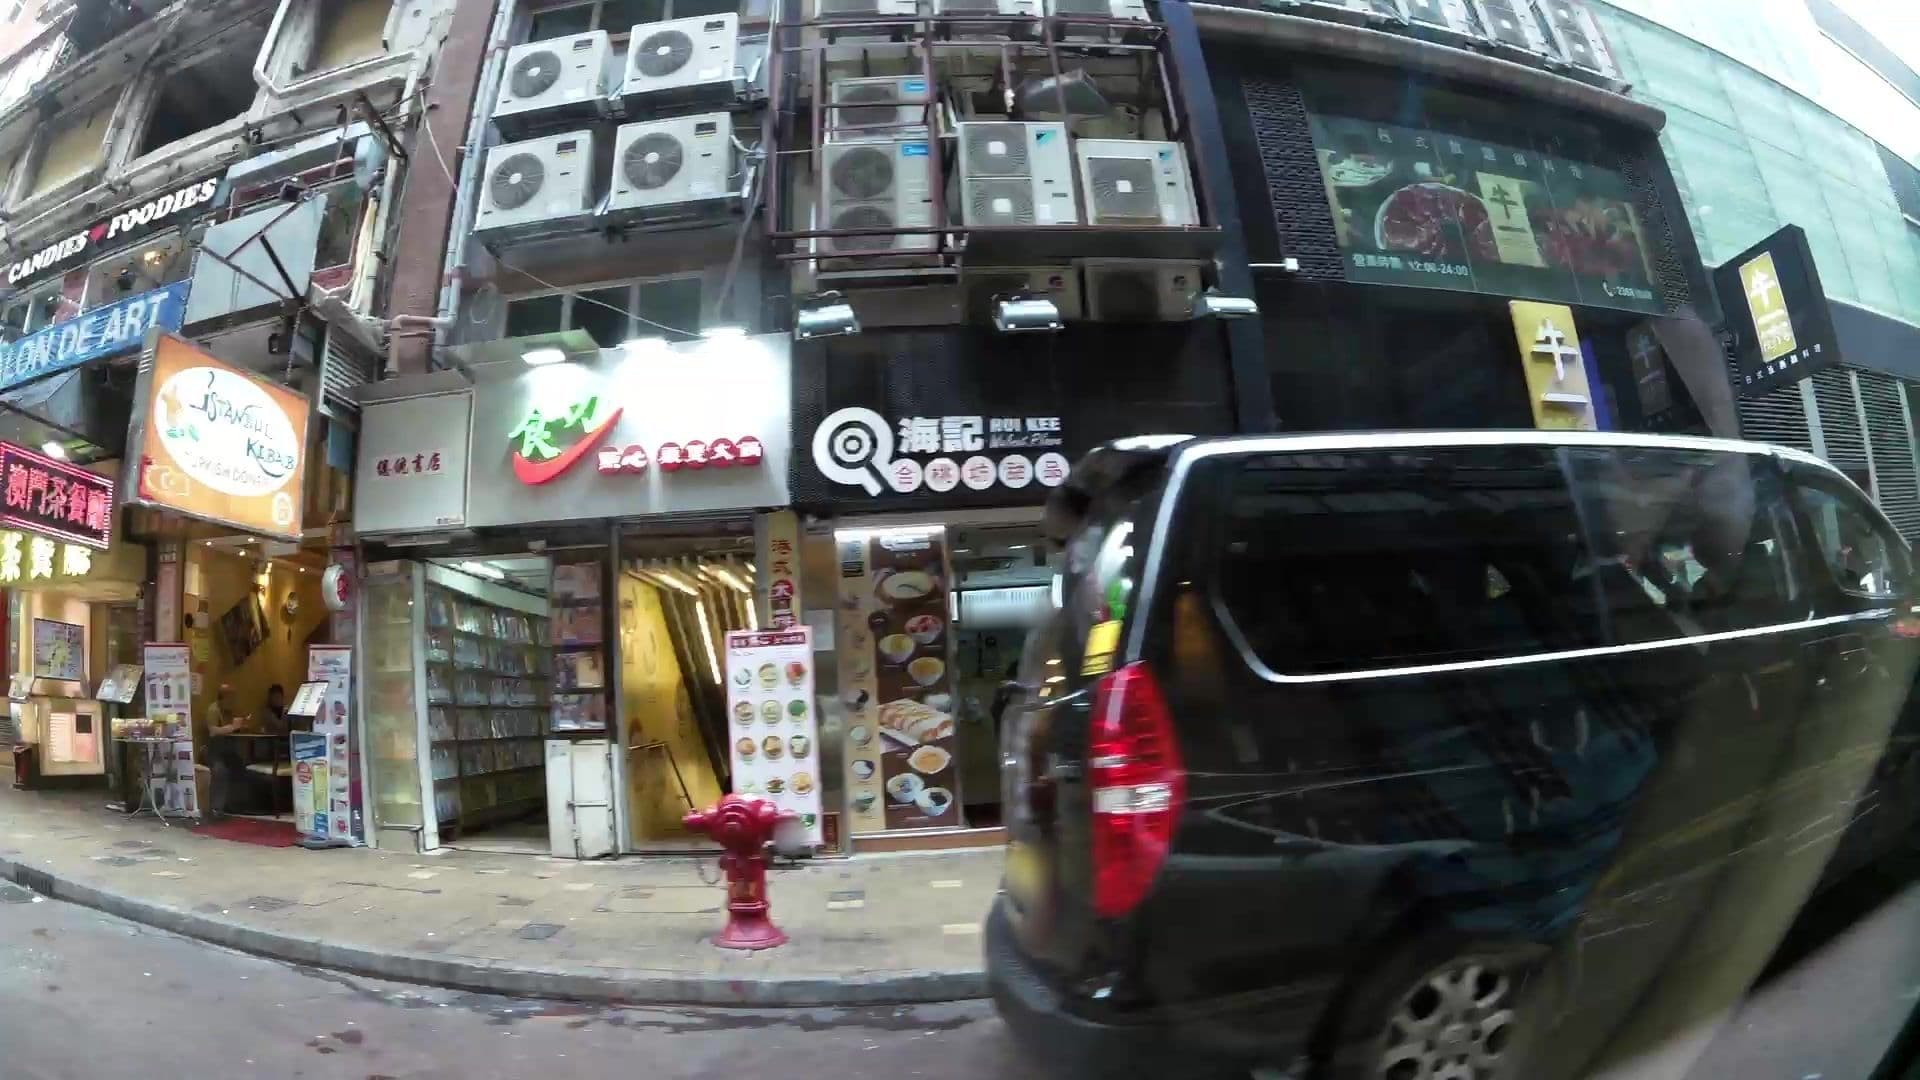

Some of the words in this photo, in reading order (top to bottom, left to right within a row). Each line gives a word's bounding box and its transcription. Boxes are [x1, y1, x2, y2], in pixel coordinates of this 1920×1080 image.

[8, 230, 89, 285] CANDIES
[107, 180, 216, 240] FOODIES
[100, 291, 169, 348] ART
[898, 415, 985, 454] 海記
